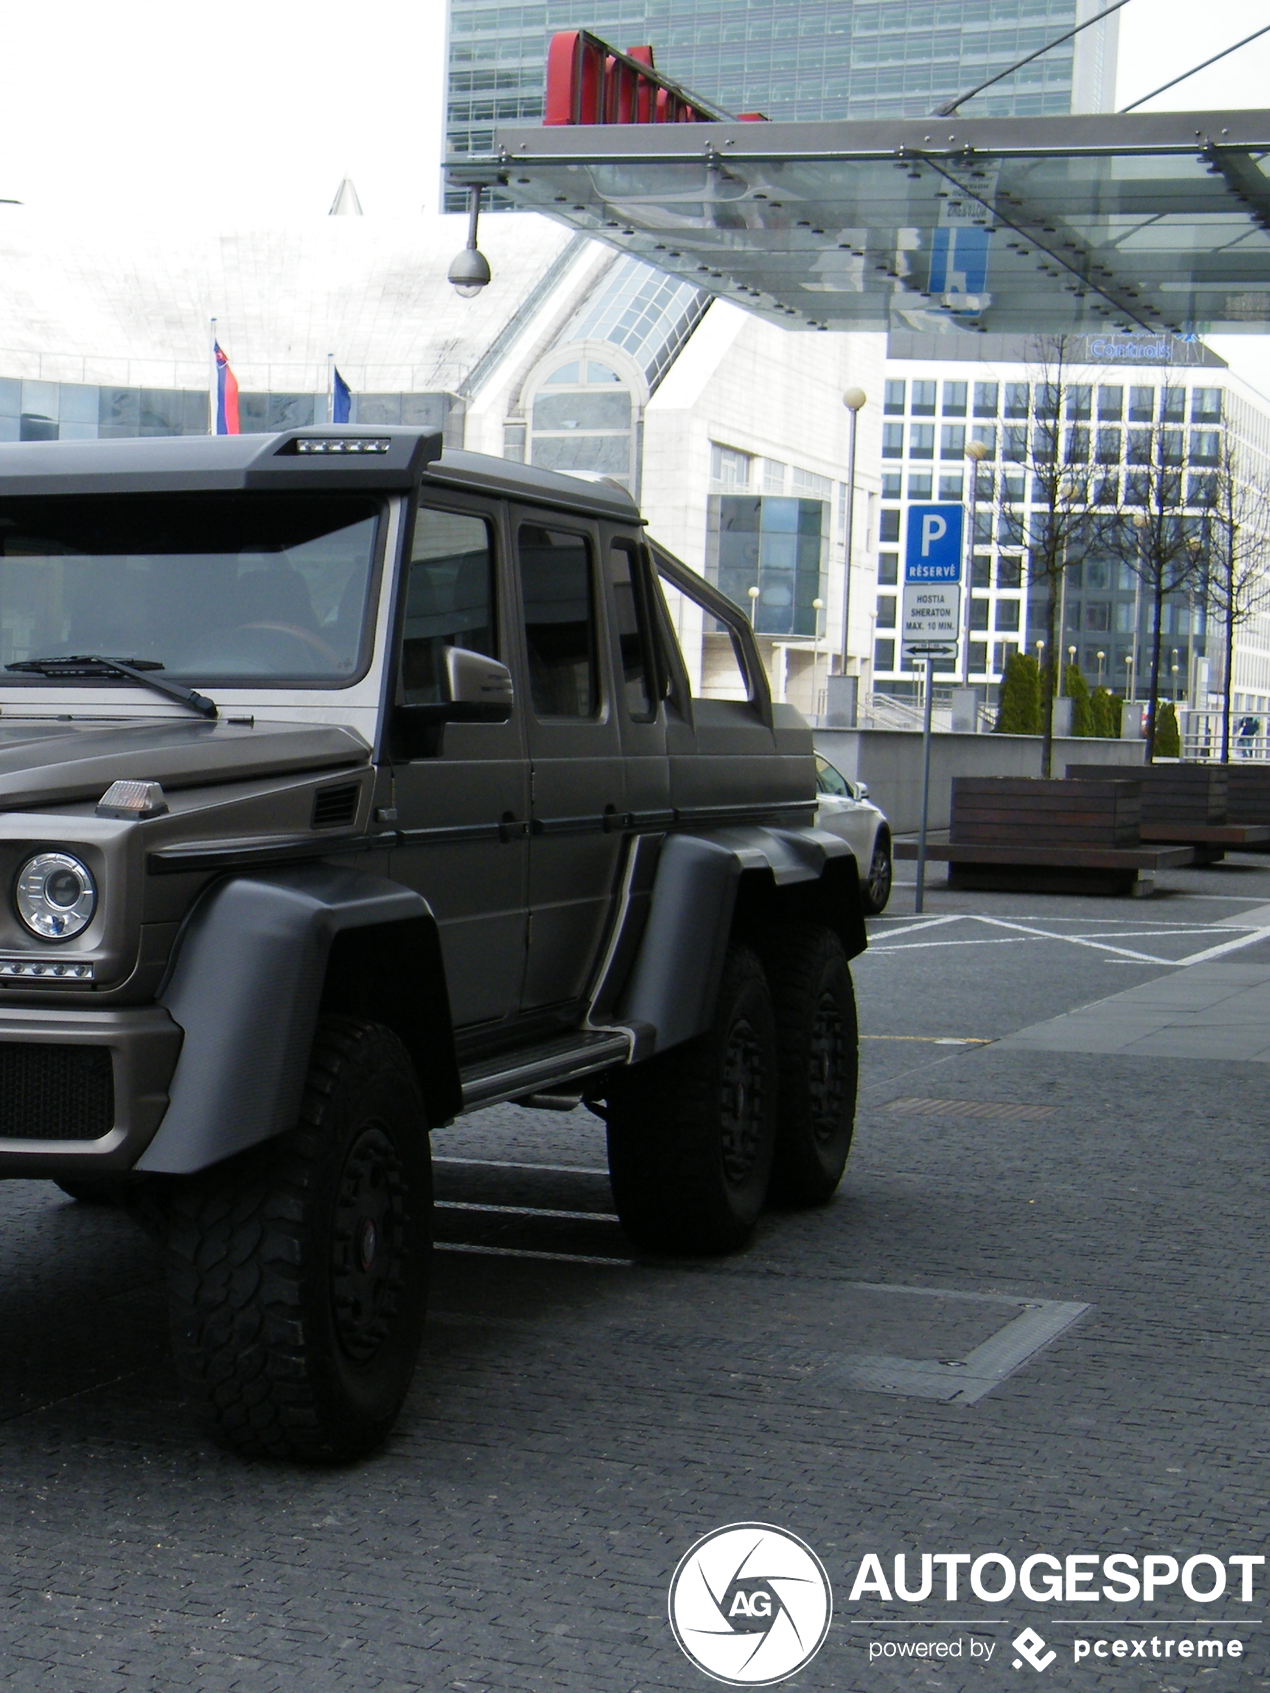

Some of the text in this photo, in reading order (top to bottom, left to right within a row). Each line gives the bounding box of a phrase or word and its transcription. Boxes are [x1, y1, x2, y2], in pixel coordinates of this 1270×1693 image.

[1090, 339, 1171, 359] Controls
[921, 514, 947, 557] P
[916, 594, 945, 604] HOSTIA
[910, 608, 951, 618] SHERATON
[905, 621, 955, 631] MAX. 10 MIN.
